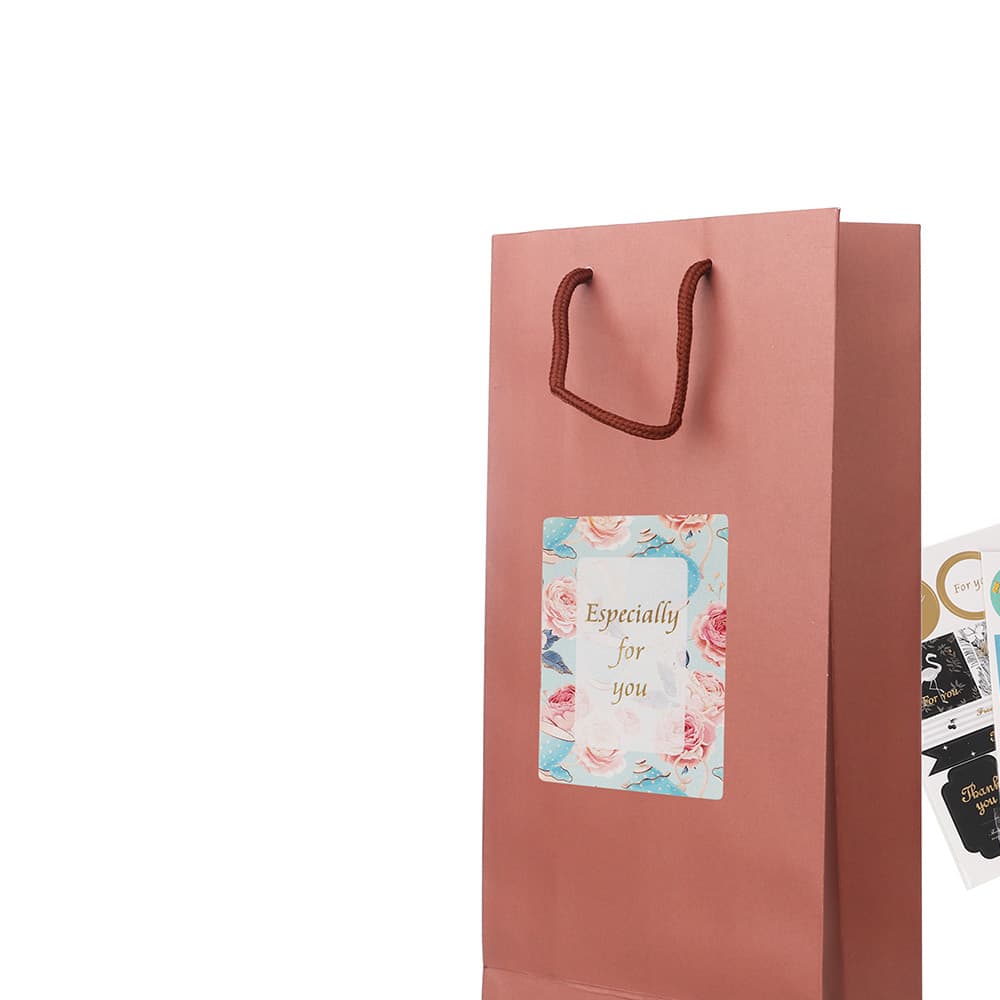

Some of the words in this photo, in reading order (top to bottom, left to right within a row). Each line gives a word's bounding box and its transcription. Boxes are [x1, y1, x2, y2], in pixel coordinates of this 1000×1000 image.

[953, 581, 971, 594] For
[585, 600, 690, 635] Especially
[607, 636, 646, 669] for
[611, 681, 648, 706] you
[922, 694, 938, 707] For
[975, 796, 998, 816] you
